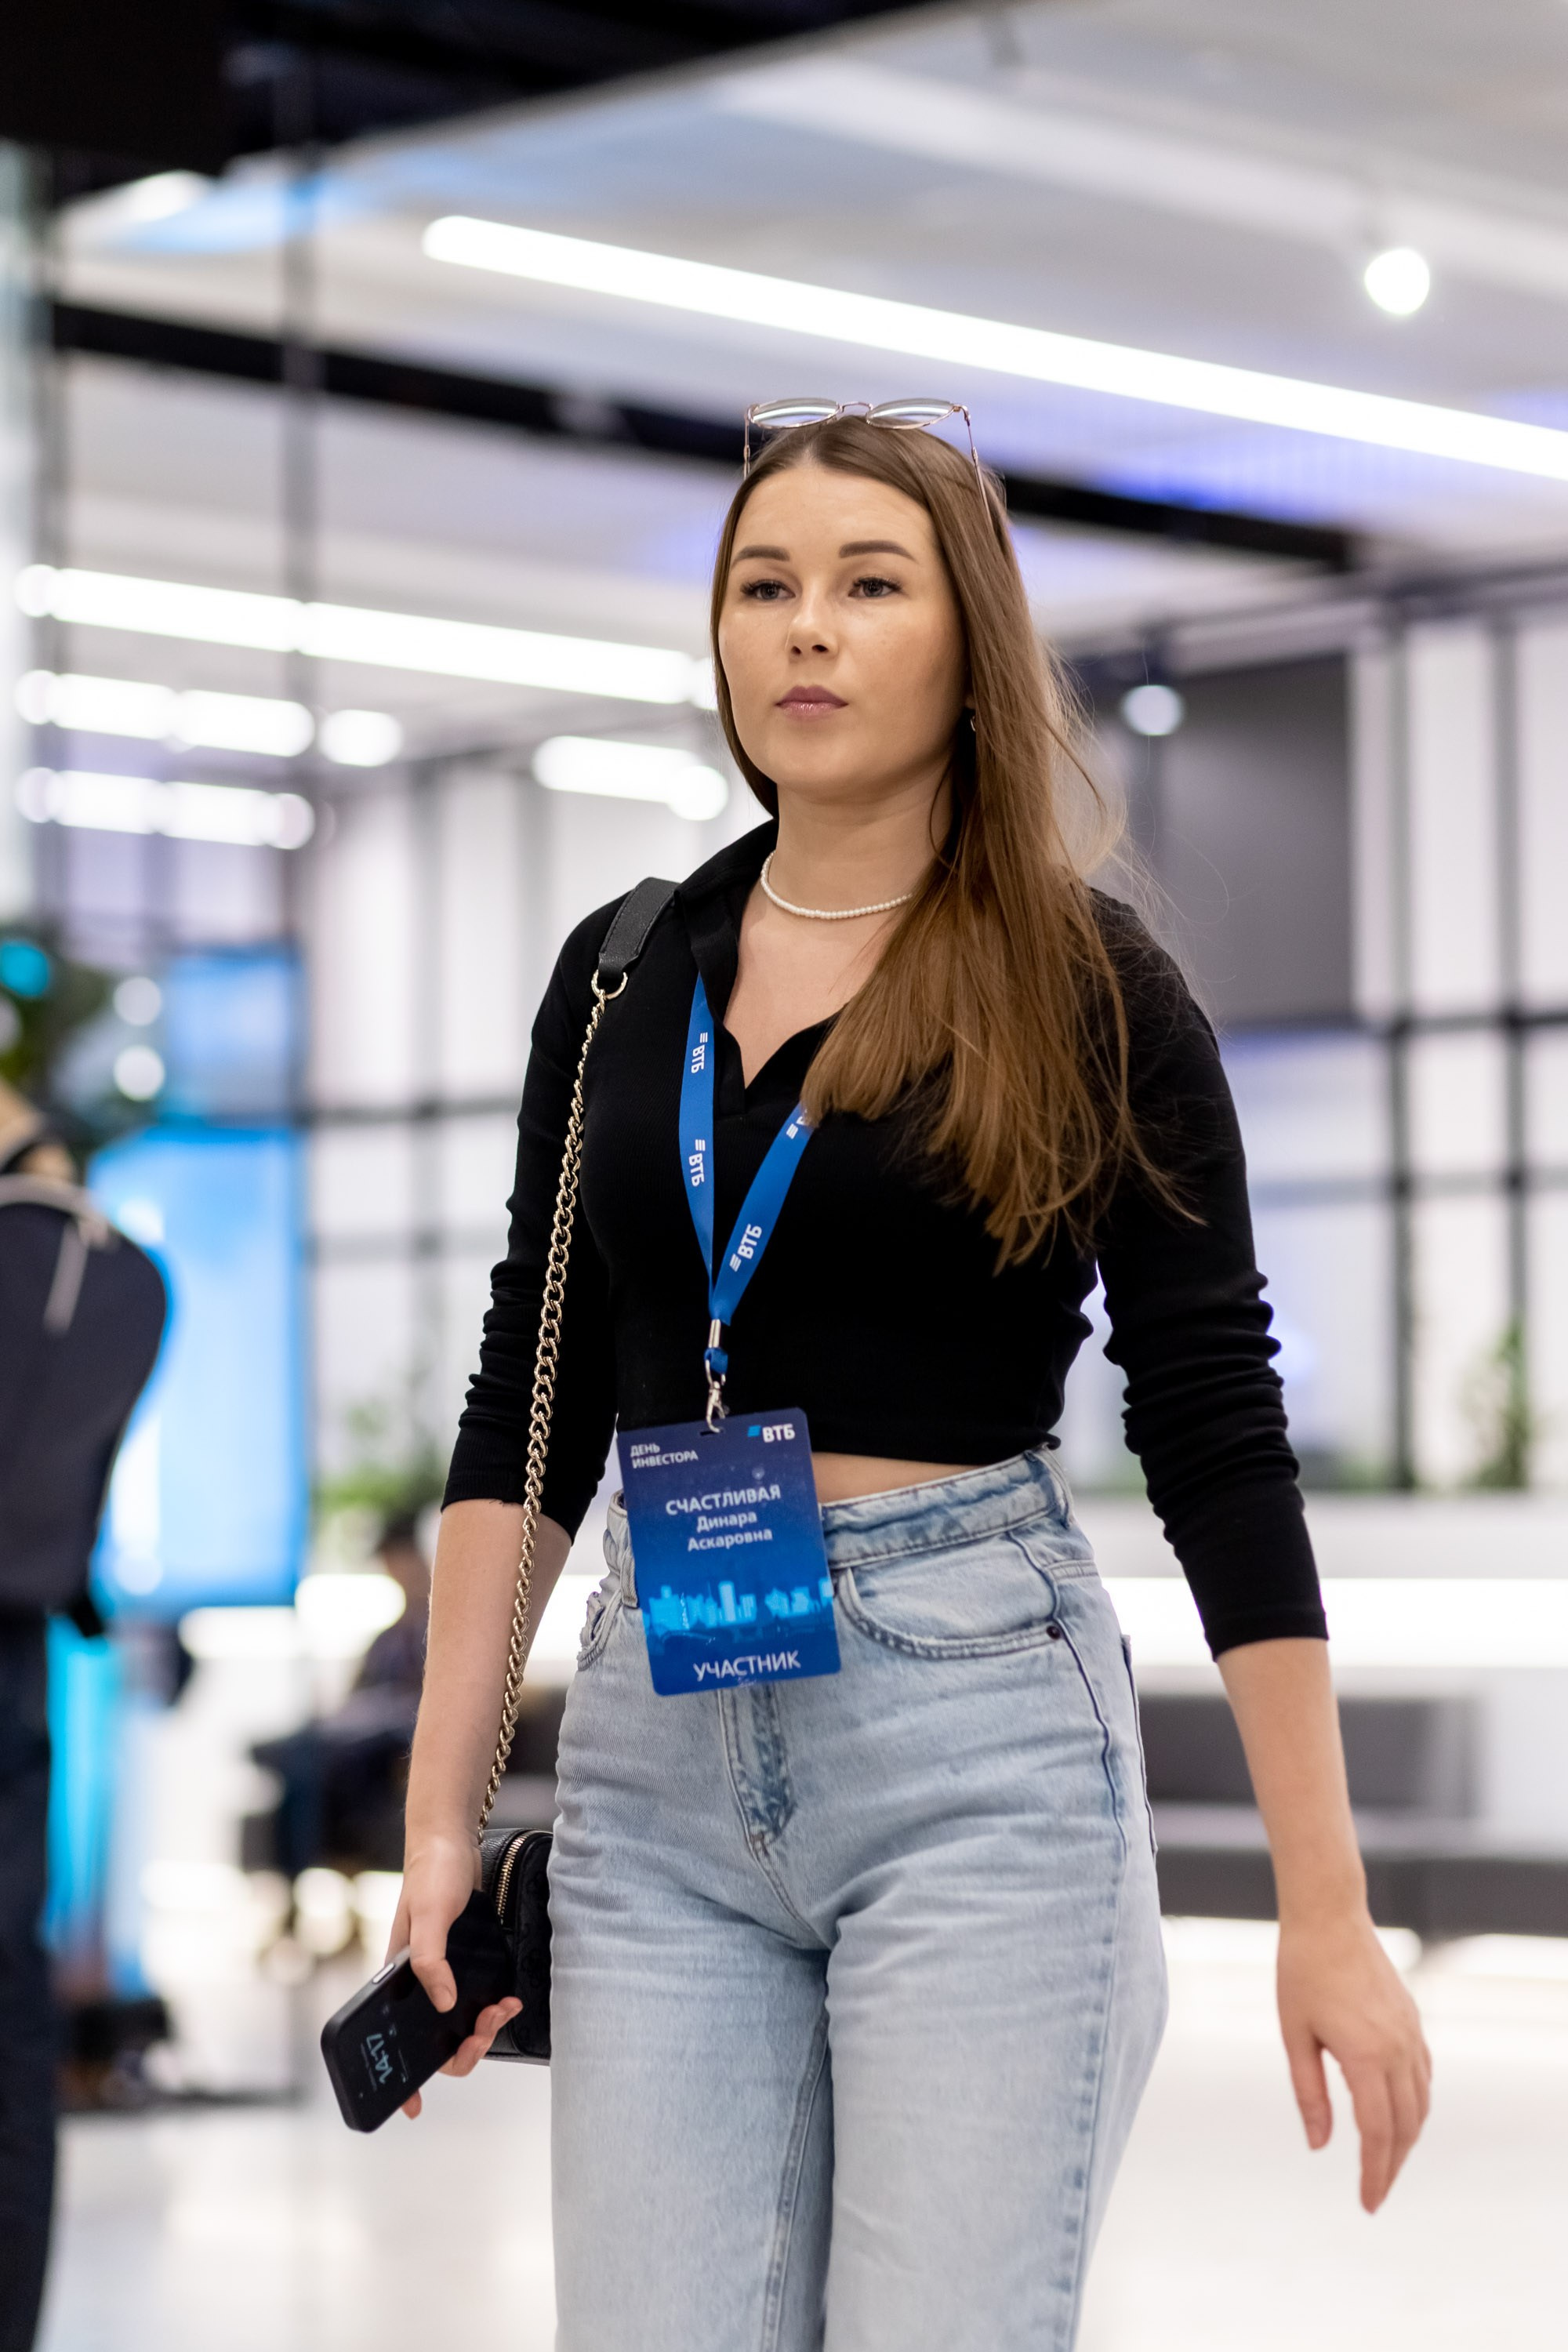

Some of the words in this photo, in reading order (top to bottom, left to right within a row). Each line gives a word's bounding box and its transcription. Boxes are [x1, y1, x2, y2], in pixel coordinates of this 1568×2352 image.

[691, 1044, 705, 1074] ВТБ
[688, 1152, 706, 1187] ВТБ
[737, 1224, 763, 1260] ВТБ
[762, 1424, 796, 1443] ВТБ
[630, 1443, 661, 1457] ДЕНЬ
[632, 1450, 699, 1469] ИНВЕСТОРА
[666, 1484, 781, 1515] СЧАСТЛИВАЯ
[696, 1510, 757, 1533] Динара
[687, 1528, 773, 1552] Аскаровна
[693, 1650, 801, 1682] УЧАСТНИК
